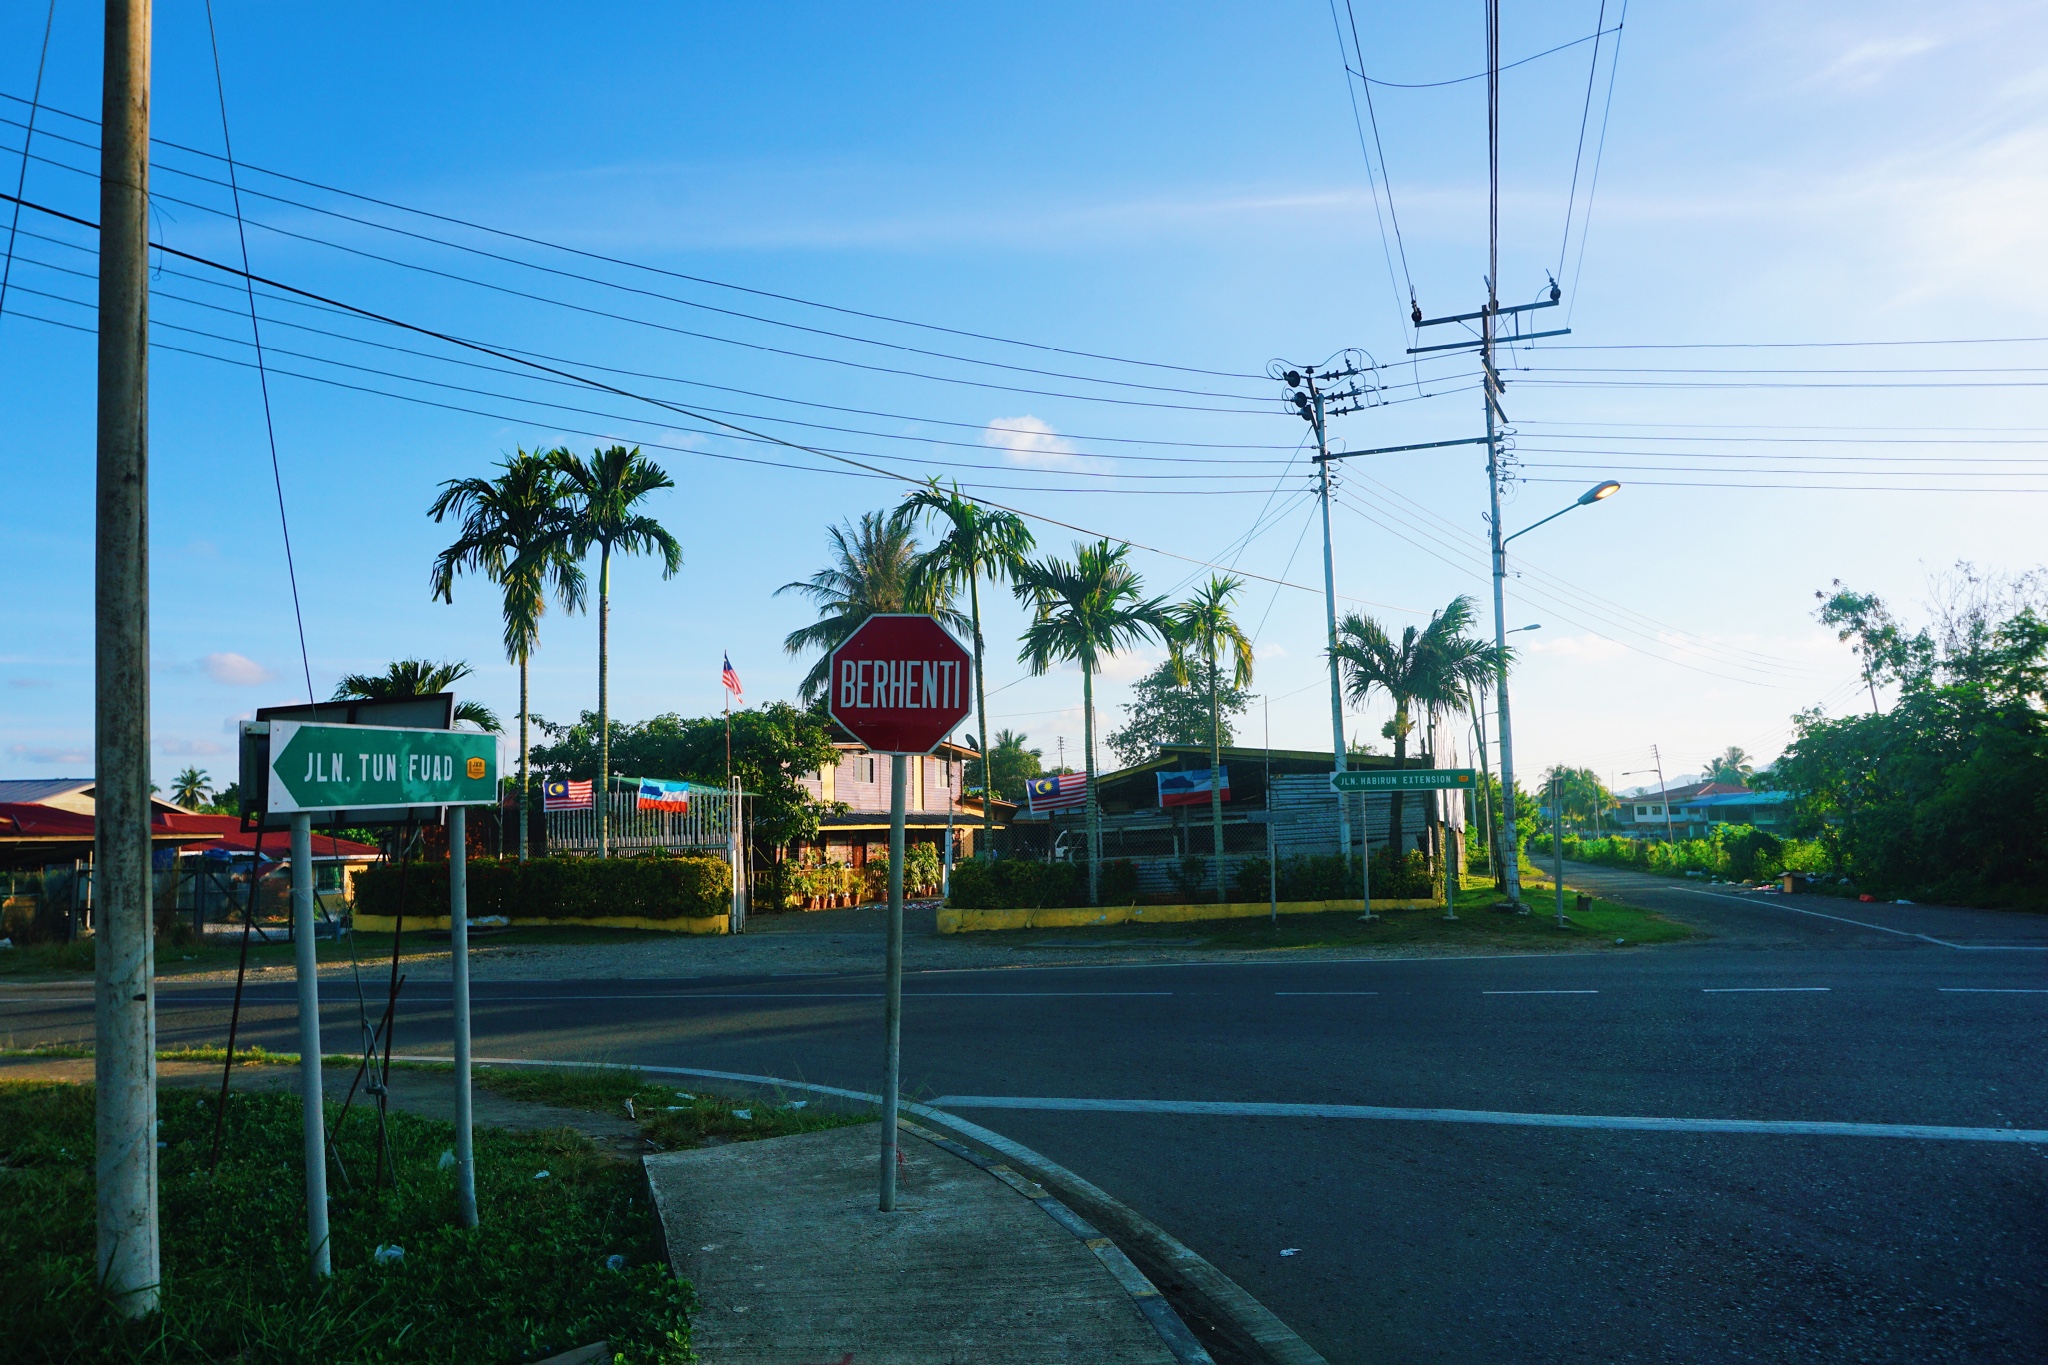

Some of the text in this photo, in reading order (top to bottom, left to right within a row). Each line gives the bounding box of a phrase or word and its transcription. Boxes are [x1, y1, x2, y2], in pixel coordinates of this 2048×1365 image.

[840, 660, 960, 708] BERHENTI
[304, 752, 453, 782] JLN. TUN FUAD
[1340, 777, 1358, 786] JLN.
[1361, 777, 1397, 785] HABIRUN
[1403, 776, 1451, 784] EXTENSION
